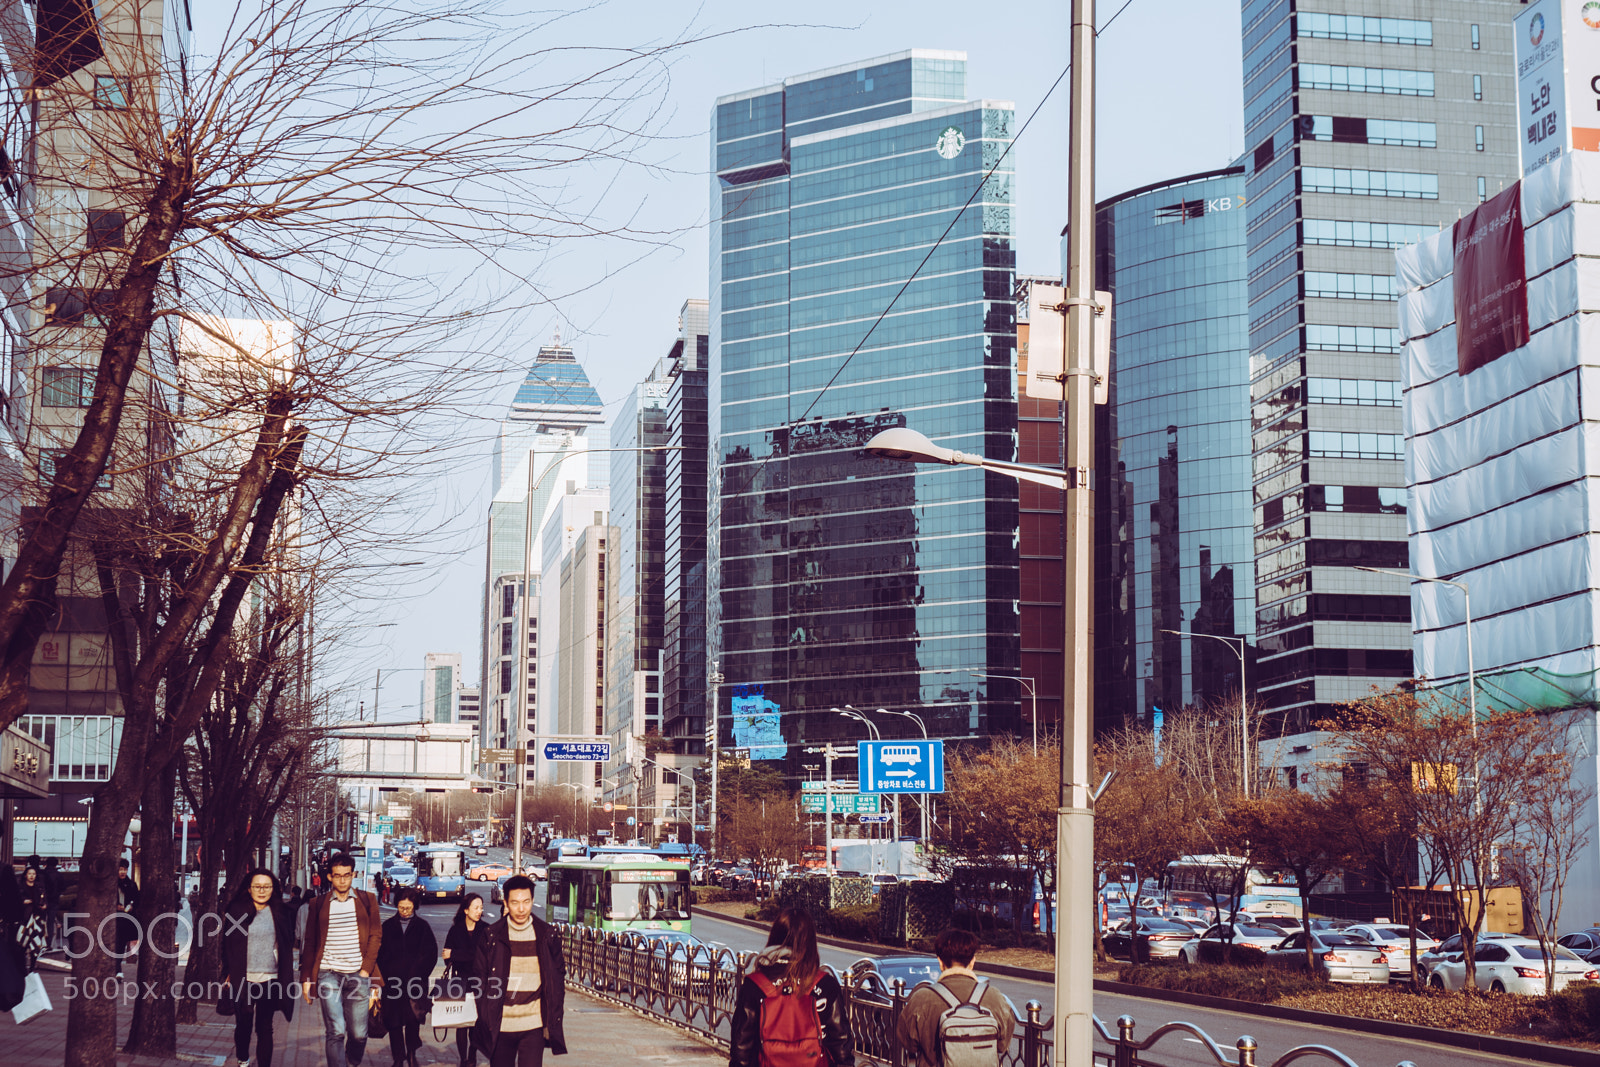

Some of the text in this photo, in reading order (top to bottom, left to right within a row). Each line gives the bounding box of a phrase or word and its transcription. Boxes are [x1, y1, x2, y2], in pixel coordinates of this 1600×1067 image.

[1531, 82, 1550, 115] 노안
[1527, 110, 1557, 145] 백내장
[1208, 197, 1232, 213] KB
[561, 744, 608, 754] 서초대로73길
[592, 753, 608, 761] 73-gil
[877, 780, 901, 789] 중앙차로
[445, 1005, 463, 1013] VISIT
